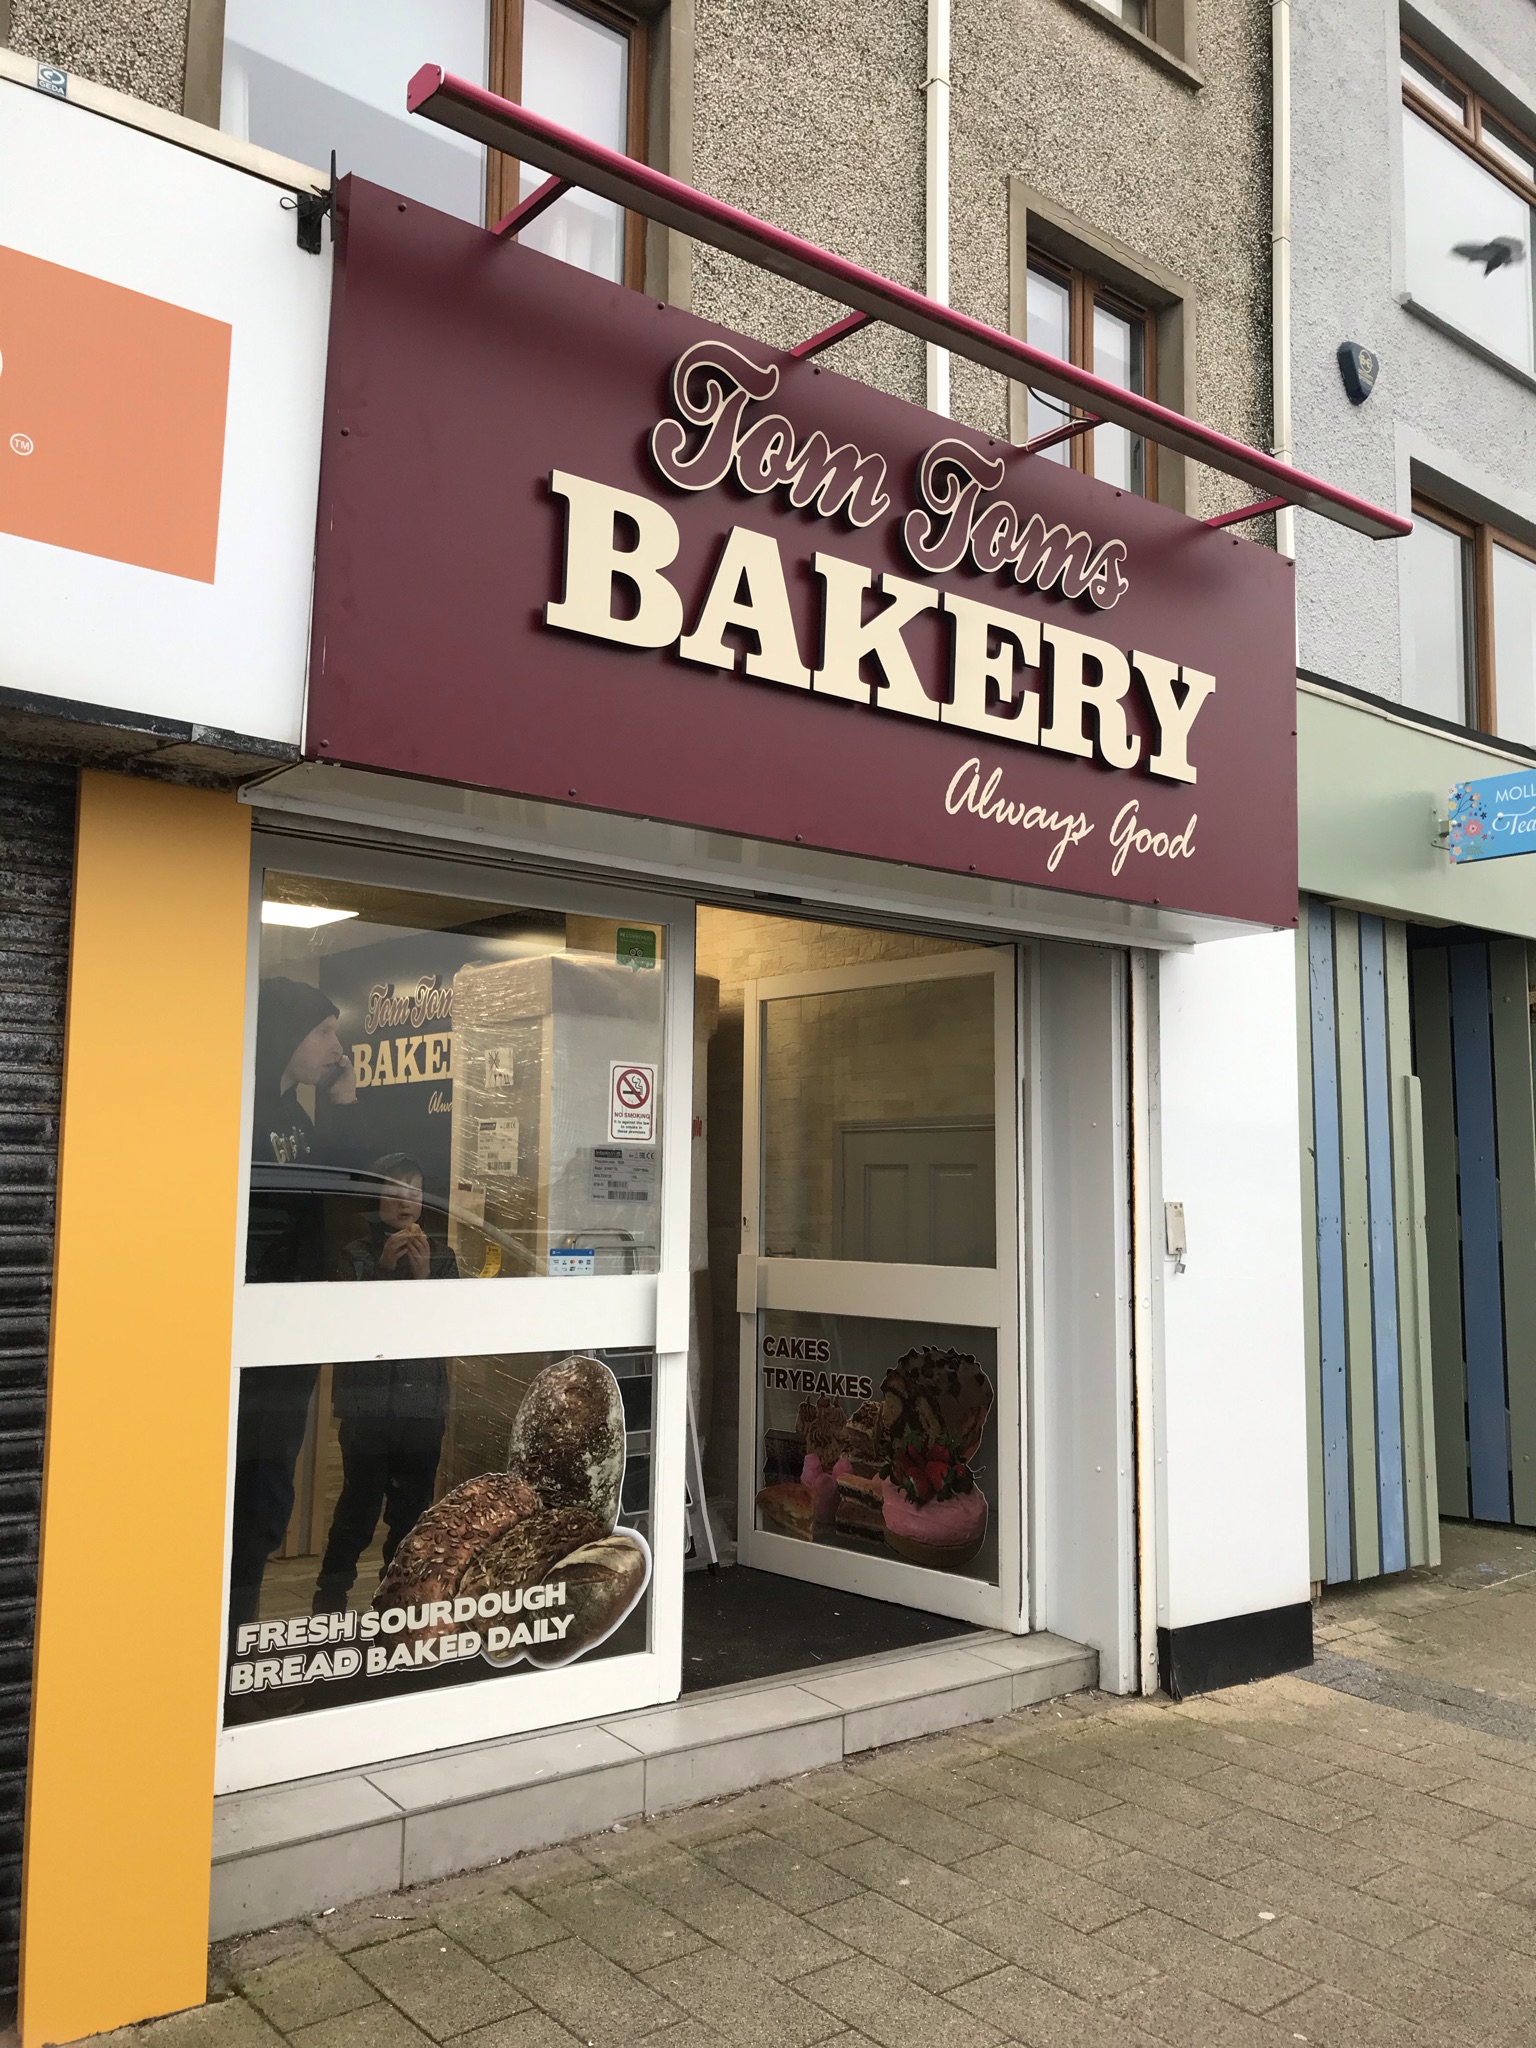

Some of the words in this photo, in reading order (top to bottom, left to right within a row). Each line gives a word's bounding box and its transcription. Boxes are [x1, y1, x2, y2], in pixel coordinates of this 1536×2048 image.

[39, 80, 65, 95] GEDA
[650, 340, 891, 527] Tom
[902, 438, 1129, 611] Toms
[544, 469, 1217, 785] BAKERY
[944, 758, 1094, 873] Always
[1108, 799, 1197, 876] Good
[364, 983, 411, 1035] Tom
[762, 1335, 831, 1363] CAKES
[762, 1366, 873, 1400] TRYBAKES
[230, 1647, 362, 1695] BREAD
[366, 1630, 482, 1676] BAKED
[488, 1614, 575, 1653] DAILY
[236, 1610, 357, 1656] FRESH
[360, 1581, 567, 1640] SOURDOUGH
